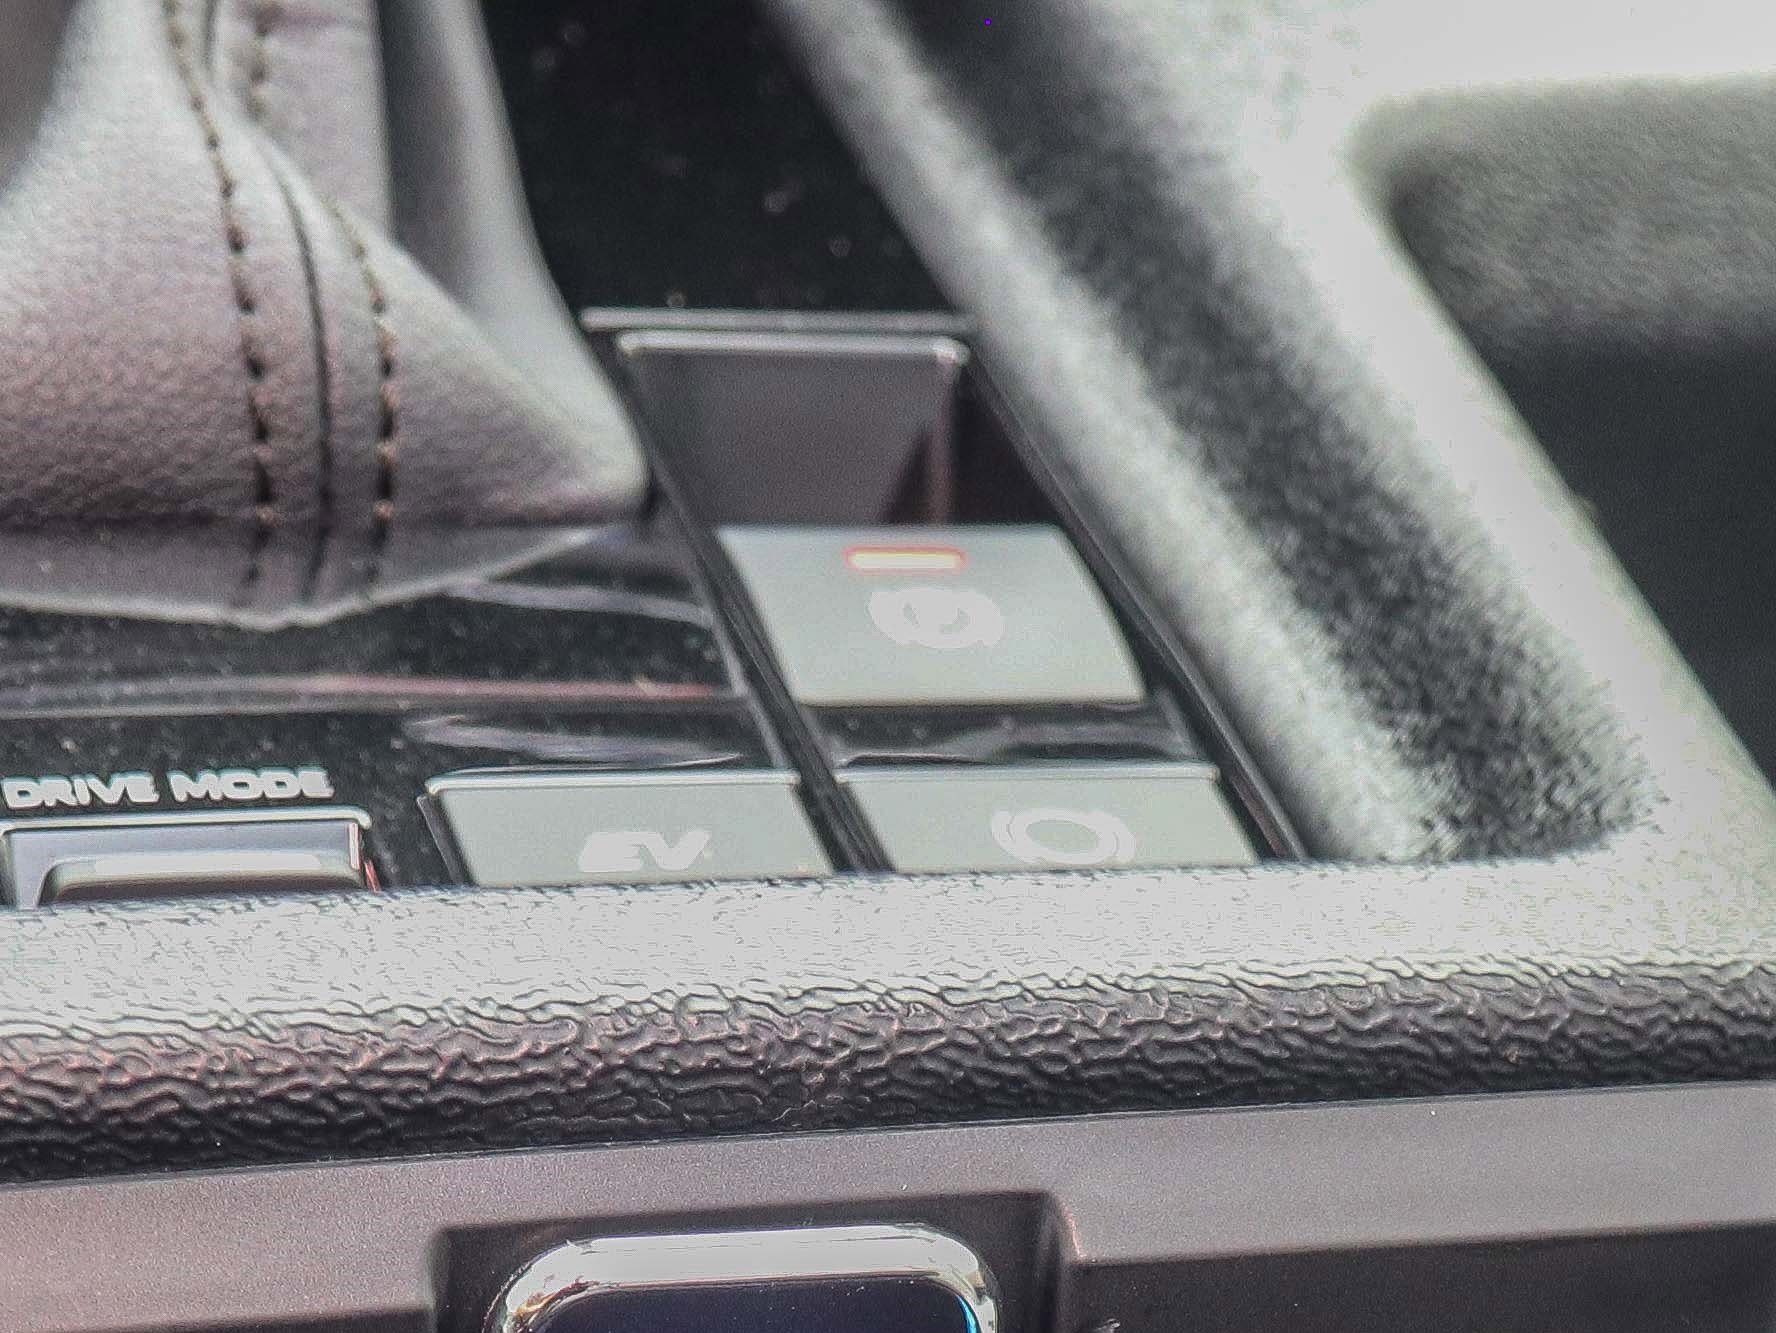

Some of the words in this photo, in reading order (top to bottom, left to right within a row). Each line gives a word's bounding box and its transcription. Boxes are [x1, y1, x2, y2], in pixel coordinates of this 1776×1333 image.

[0, 771, 160, 809] DRIVE
[166, 765, 334, 802] MODE
[578, 831, 712, 873] EV
